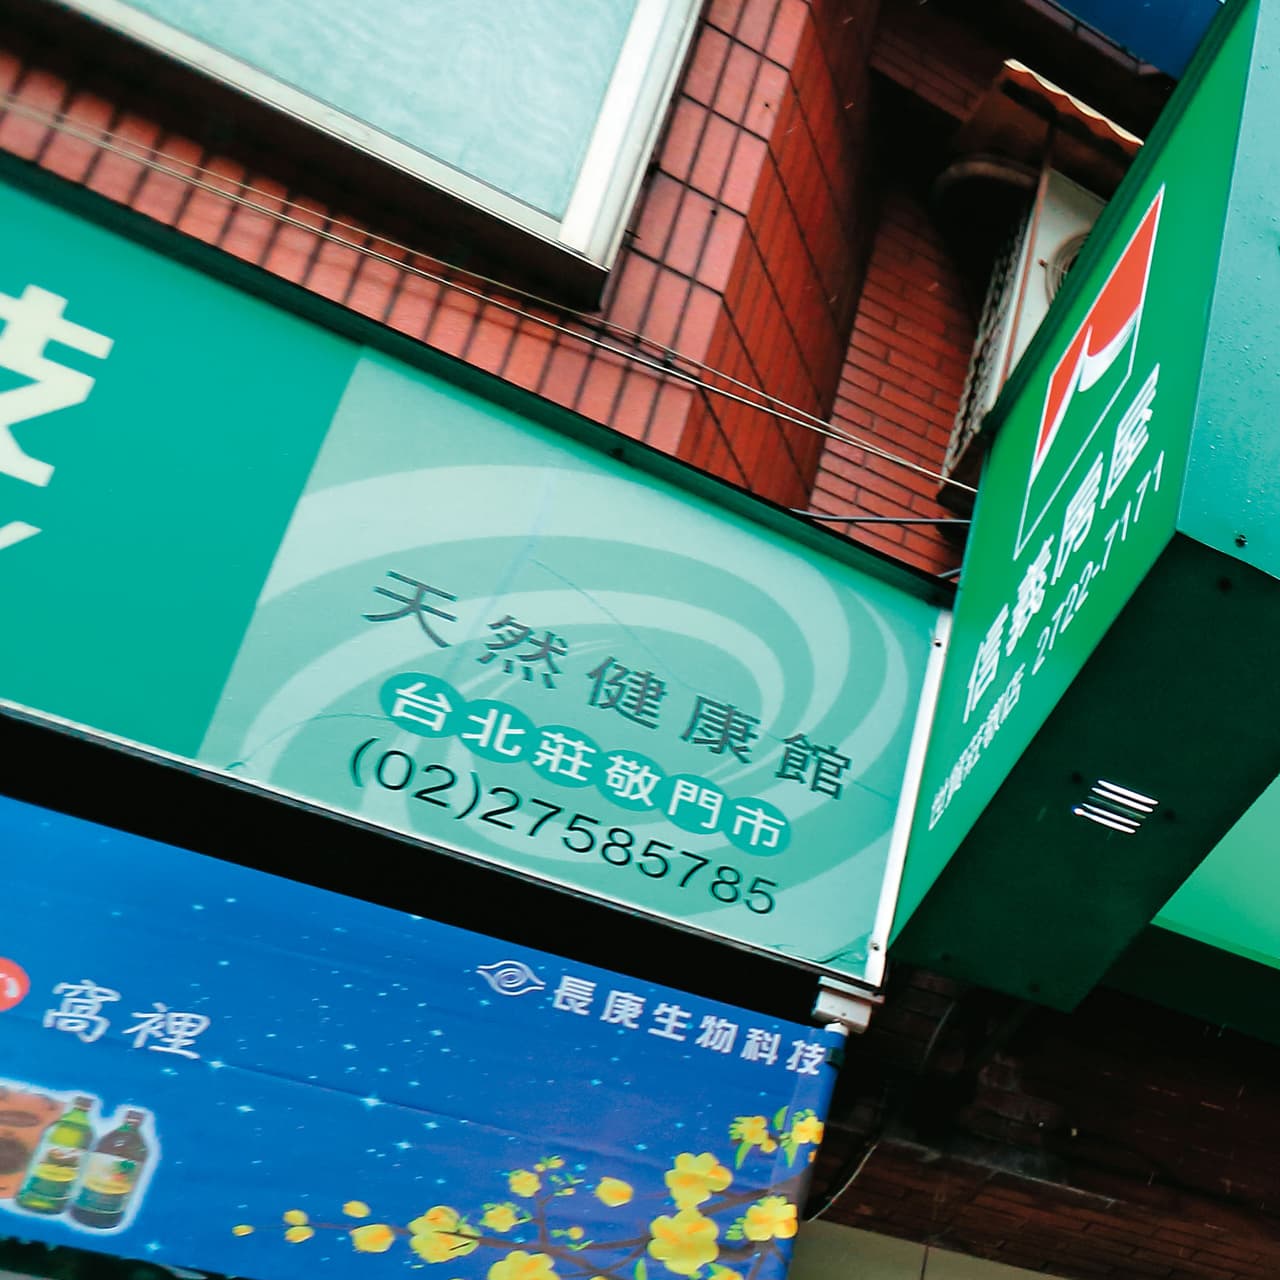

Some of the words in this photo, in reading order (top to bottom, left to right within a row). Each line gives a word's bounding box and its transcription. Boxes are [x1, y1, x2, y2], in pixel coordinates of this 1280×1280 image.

[964, 362, 1162, 724] 信義房屋
[1031, 450, 1165, 677] 2722-7171
[363, 569, 853, 800] 天然健康館
[388, 678, 788, 852] 台北莊敬門市
[349, 736, 777, 916] (02)27585785
[42, 978, 212, 1060] 窩裡
[552, 974, 828, 1076] 長庚生物科技
